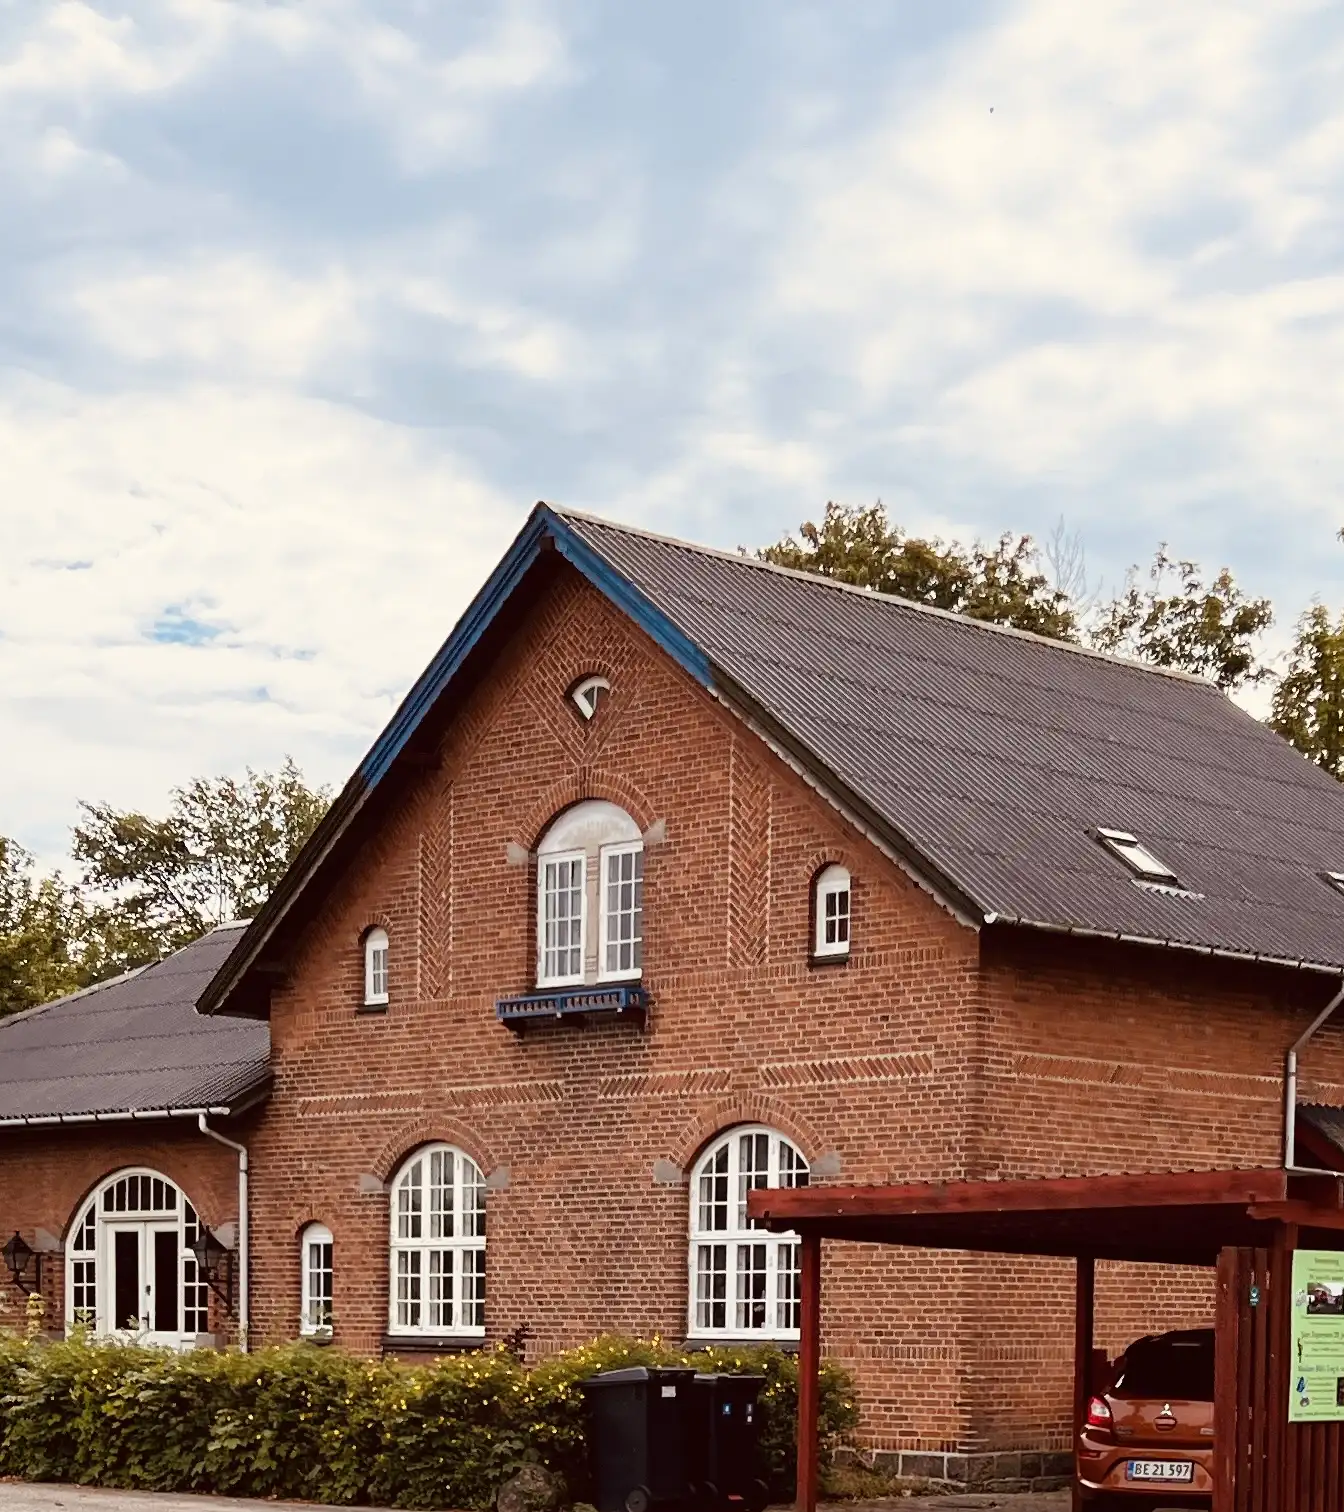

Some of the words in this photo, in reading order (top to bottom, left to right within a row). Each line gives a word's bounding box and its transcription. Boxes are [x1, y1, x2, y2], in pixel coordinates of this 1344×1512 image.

[1134, 1463, 1149, 1475] BE
[1151, 1463, 1164, 1476] 21
[1168, 1464, 1190, 1477] 597
